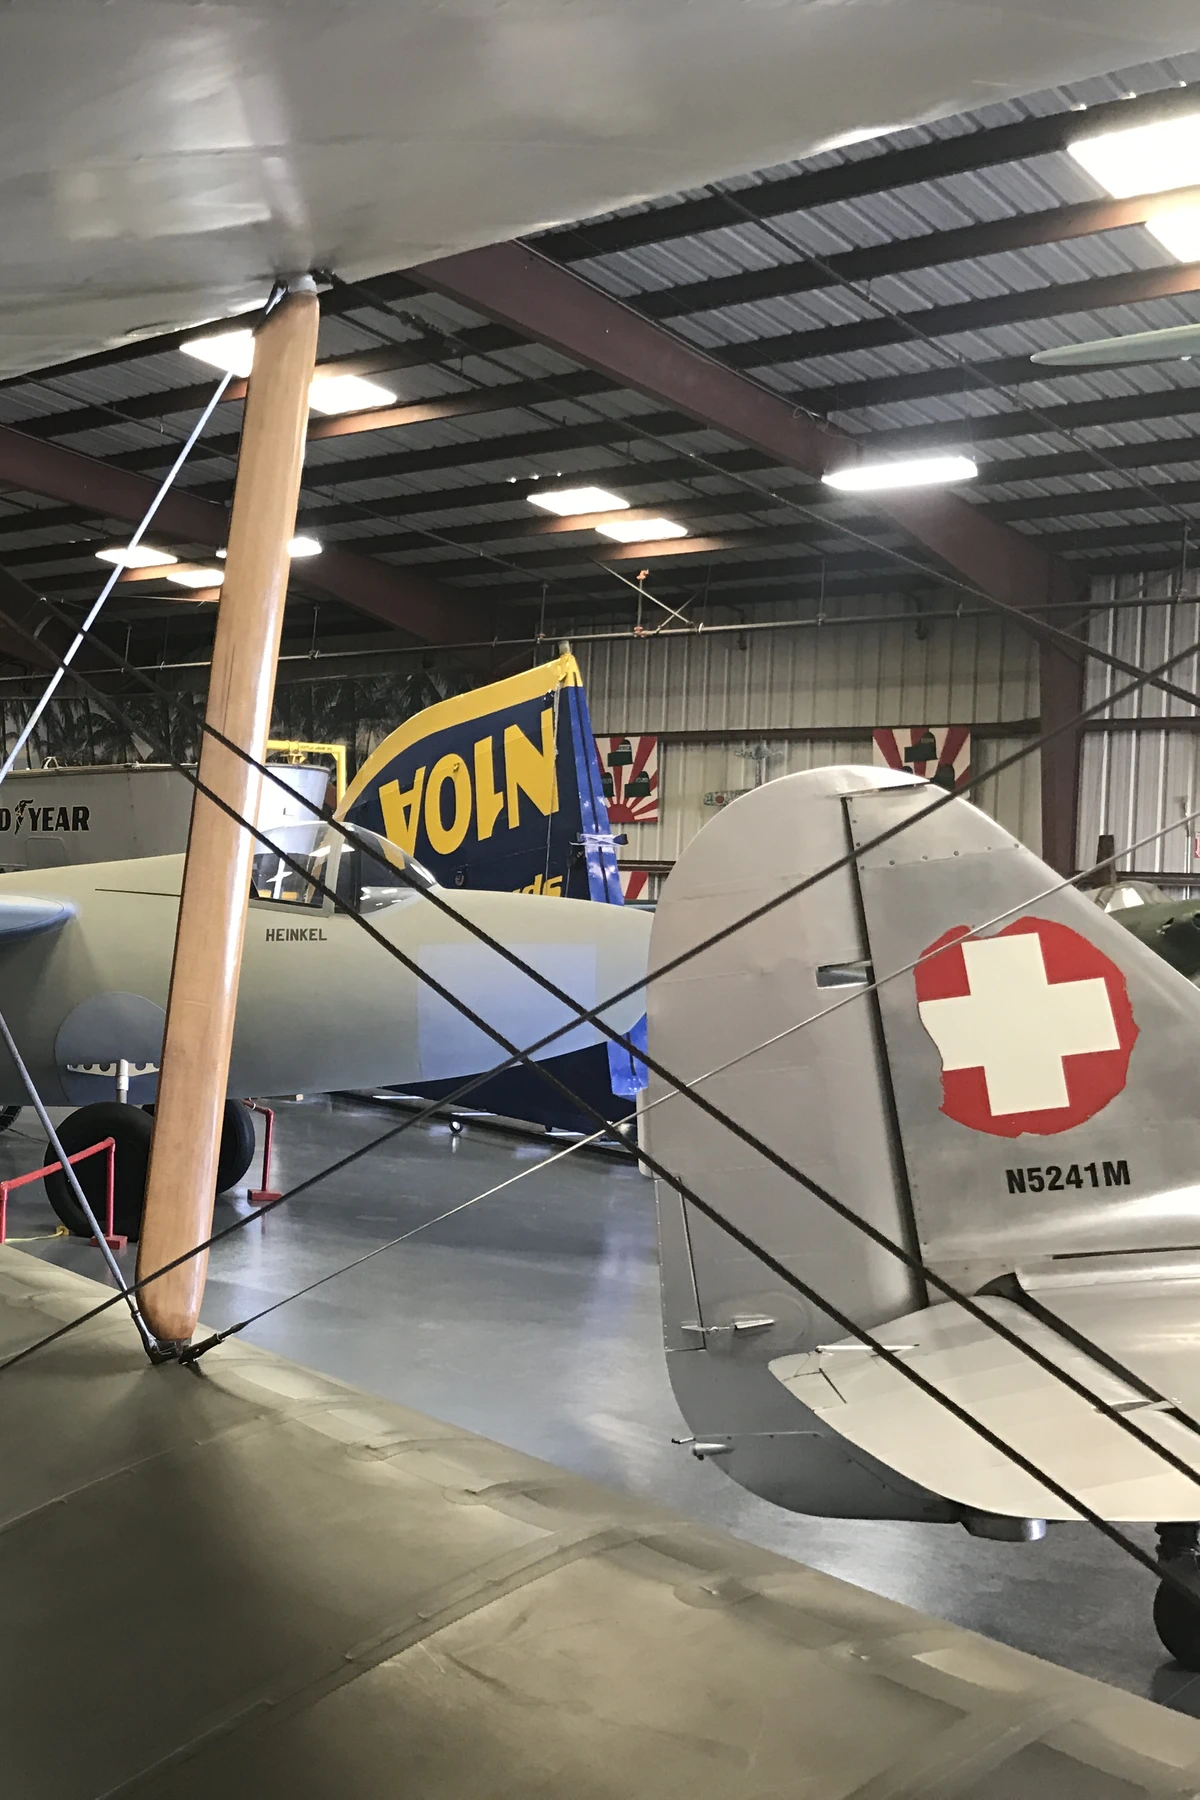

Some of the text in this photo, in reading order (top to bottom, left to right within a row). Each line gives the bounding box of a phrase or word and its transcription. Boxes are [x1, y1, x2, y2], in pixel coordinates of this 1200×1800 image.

[378, 707, 560, 870] N10A
[28, 806, 90, 831] YEAR
[266, 929, 327, 941] HEINKEL
[1005, 1160, 1131, 1194] N5241M
